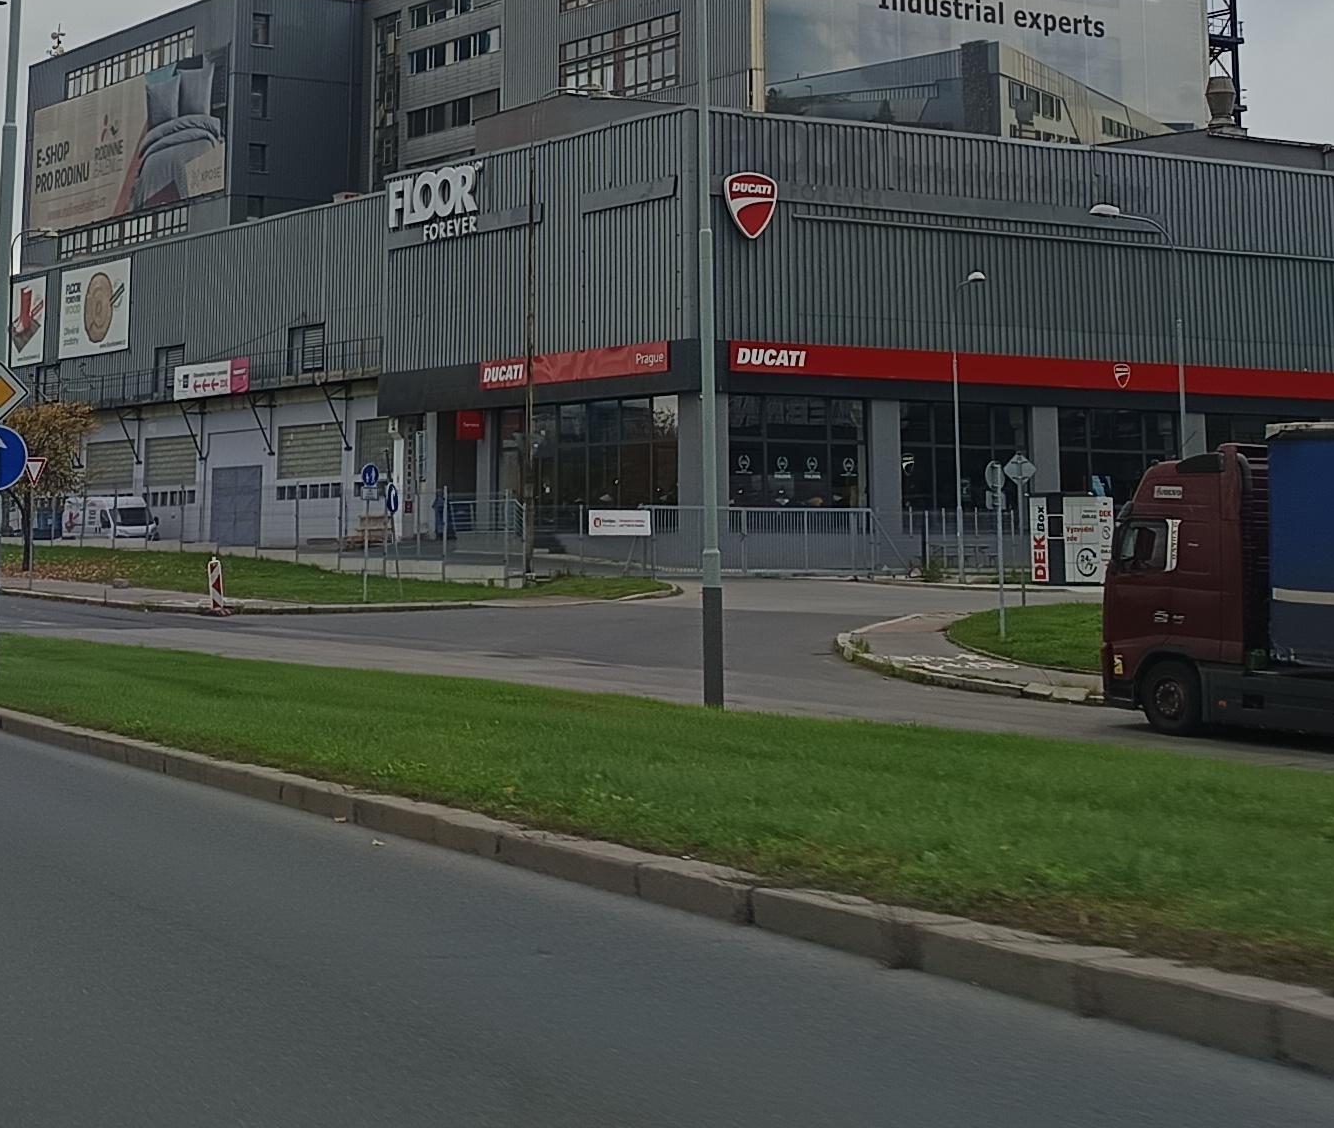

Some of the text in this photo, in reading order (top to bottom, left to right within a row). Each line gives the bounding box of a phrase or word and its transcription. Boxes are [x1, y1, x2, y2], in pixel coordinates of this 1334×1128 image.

[1013, 8, 1105, 38] experts
[36, 140, 70, 168] E-SHOP
[35, 171, 53, 194] PRO
[54, 160, 90, 189] RODINU
[731, 182, 772, 195] DUCATI
[388, 164, 478, 229] FLOOR
[423, 216, 477, 241] FOREVER
[635, 352, 664, 368] Prague
[736, 347, 806, 367] DUCATI
[483, 363, 524, 384] DUCATI
[1033, 534, 1047, 580] DEK
